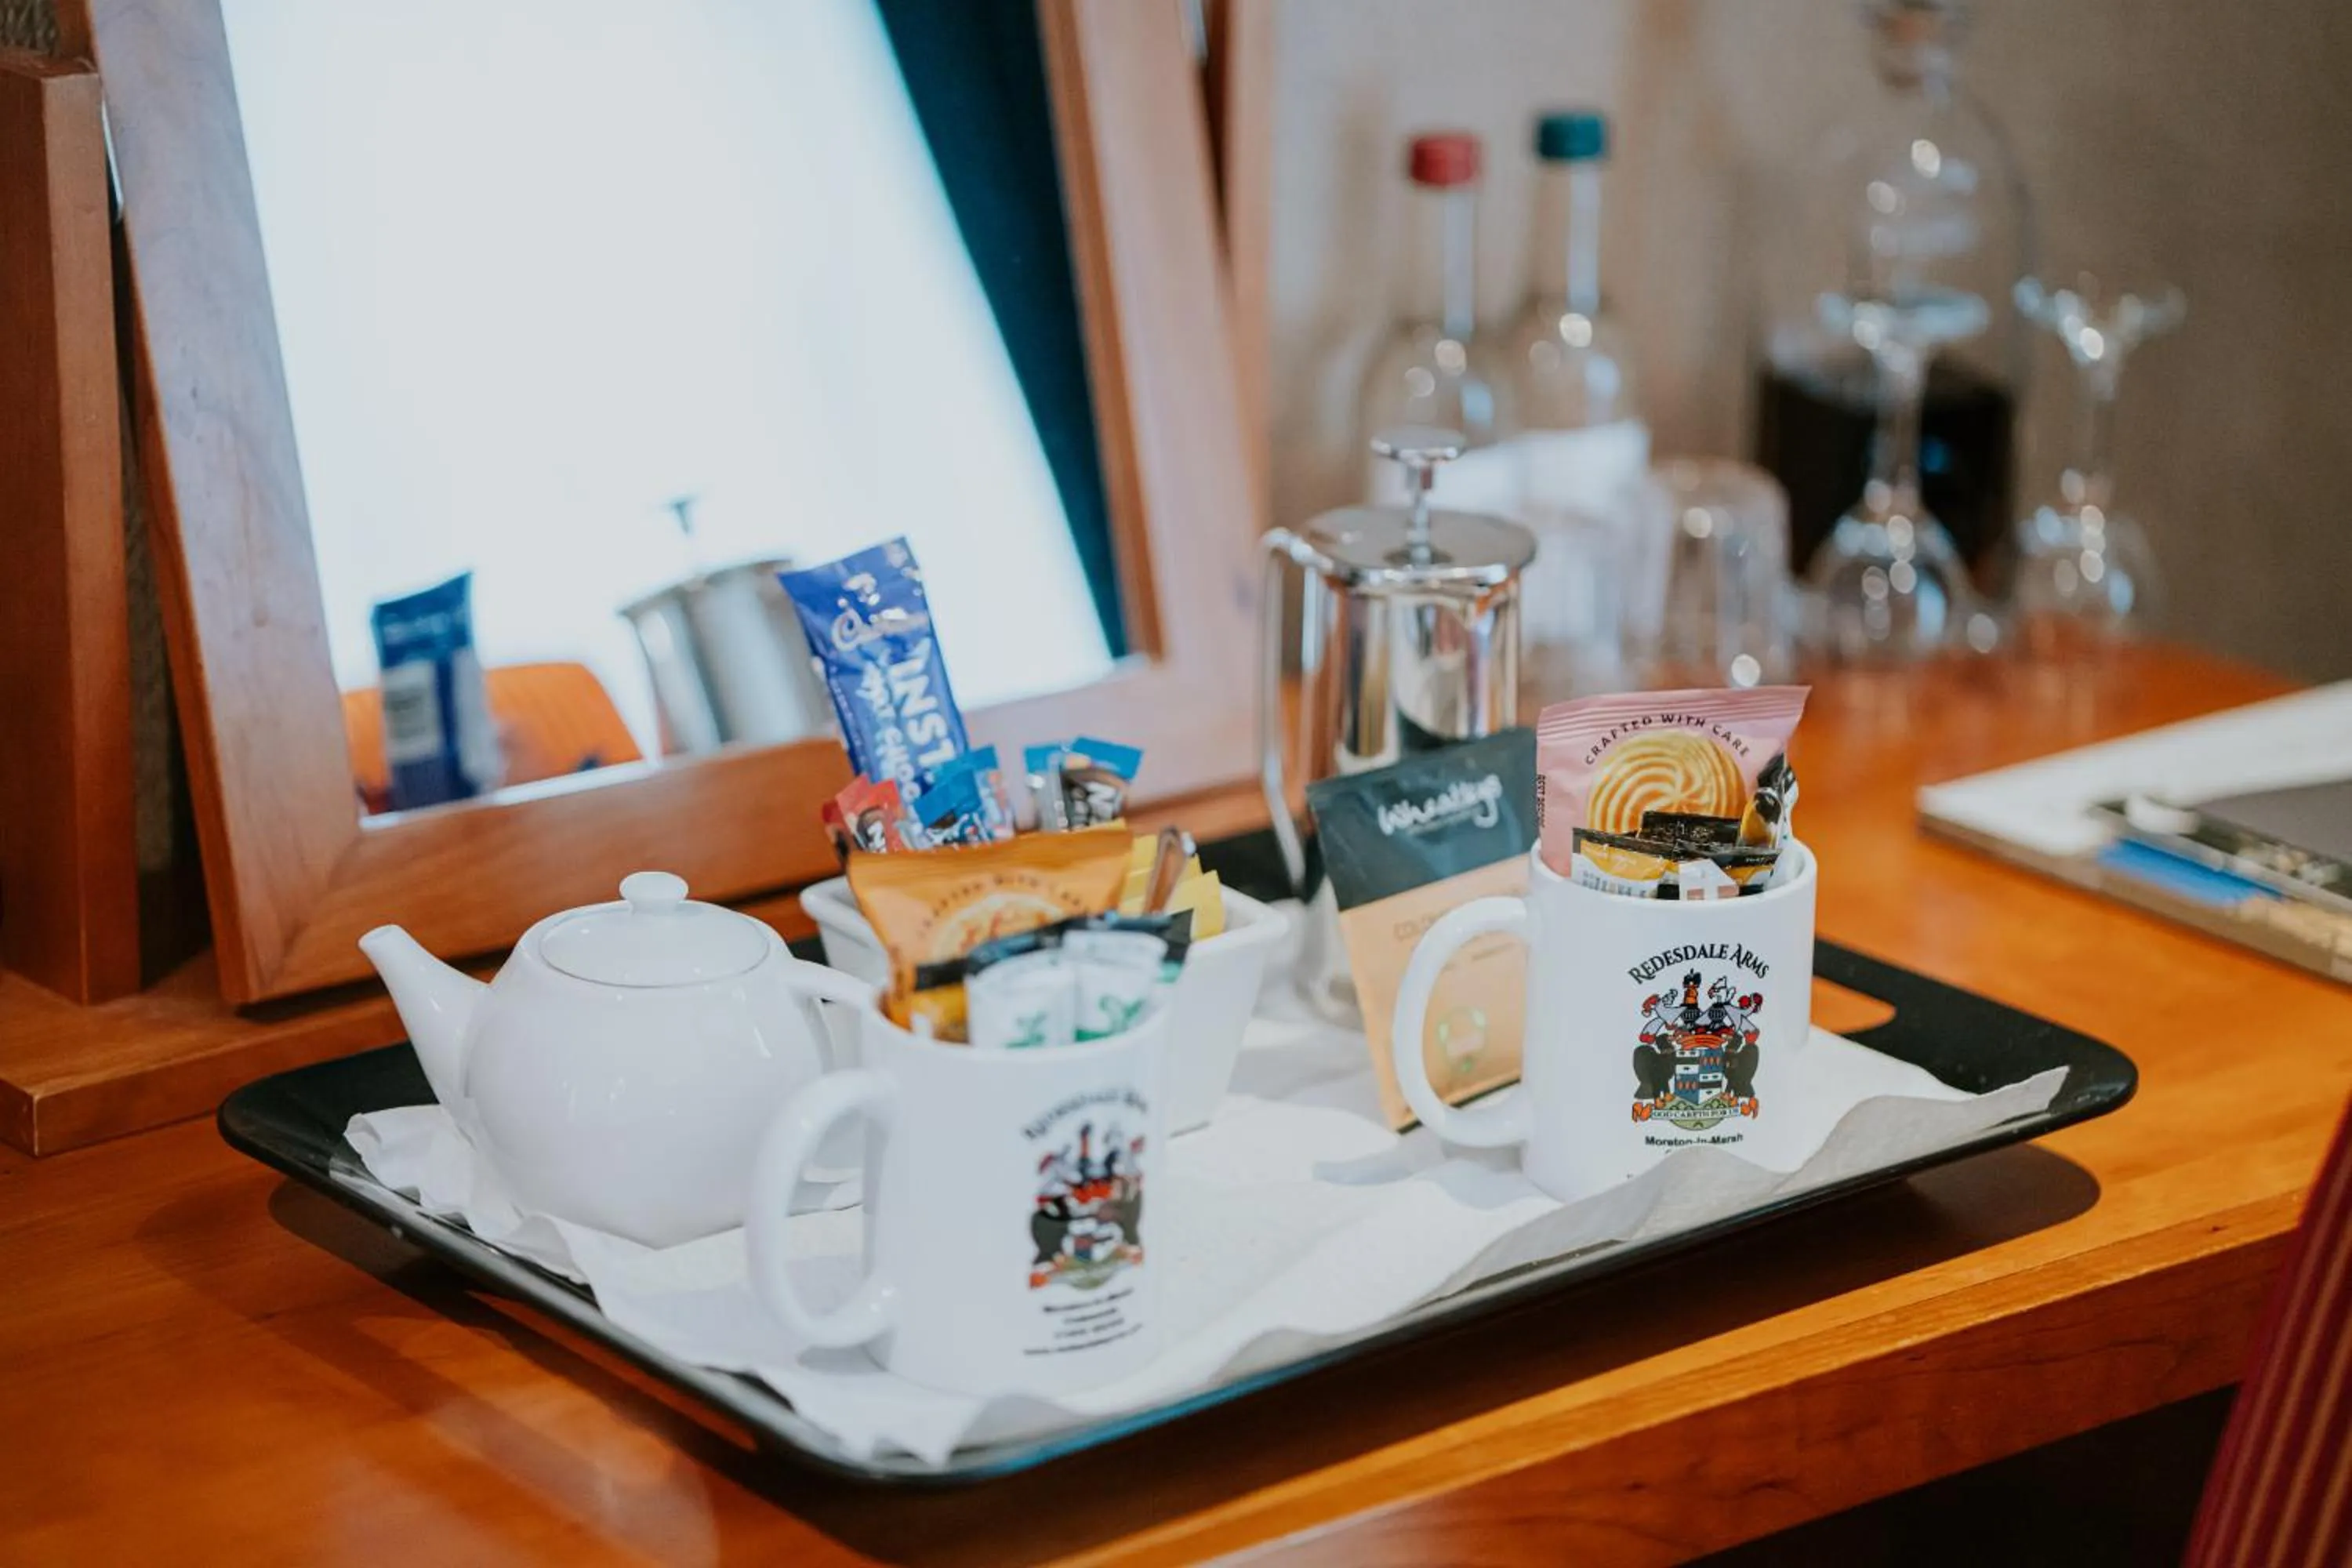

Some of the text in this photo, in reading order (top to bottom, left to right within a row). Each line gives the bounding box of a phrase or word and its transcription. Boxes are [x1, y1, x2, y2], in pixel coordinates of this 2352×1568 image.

[1584, 715, 1653, 765] CRAFTED
[1661, 713, 1706, 728] WITH
[1627, 942, 1769, 985] REDESDALE ARMS
